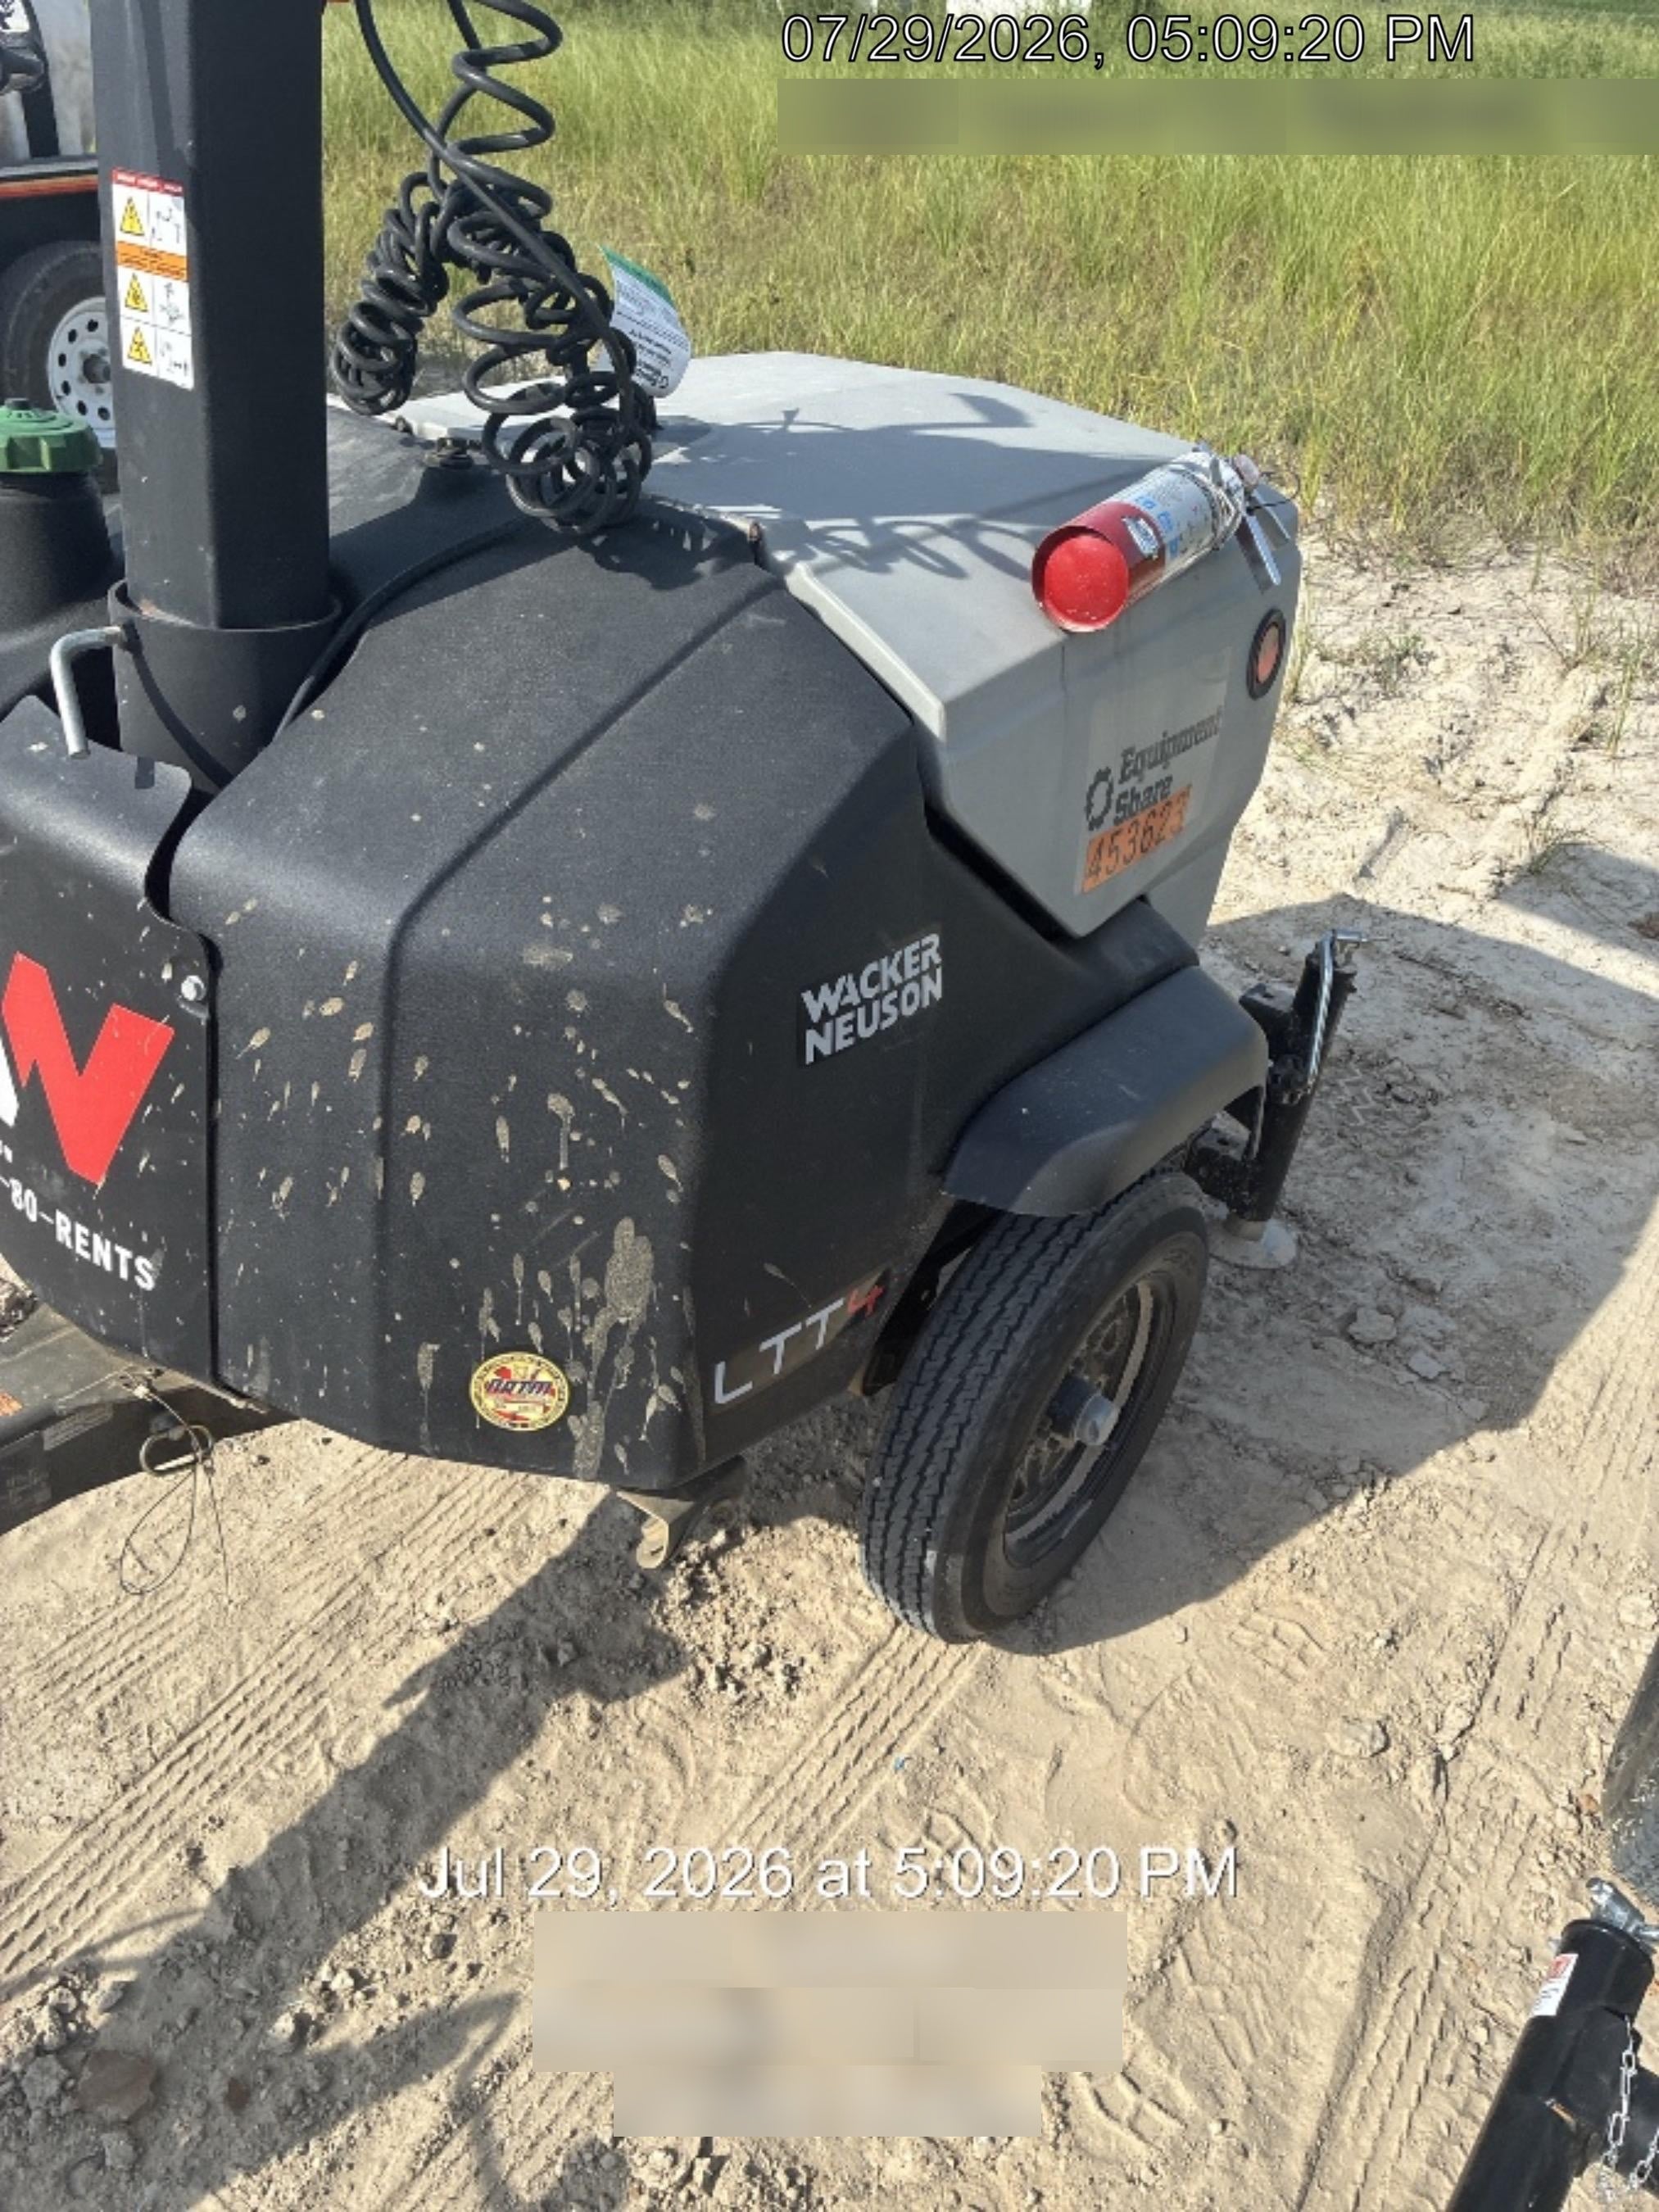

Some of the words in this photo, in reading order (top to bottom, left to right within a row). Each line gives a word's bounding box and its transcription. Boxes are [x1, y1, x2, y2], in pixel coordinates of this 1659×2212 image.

[1118, 708, 1222, 783] Equipment
[1113, 775, 1173, 826] Share
[800, 932, 941, 1023] WACKER
[805, 965, 942, 1065] NEUSON
